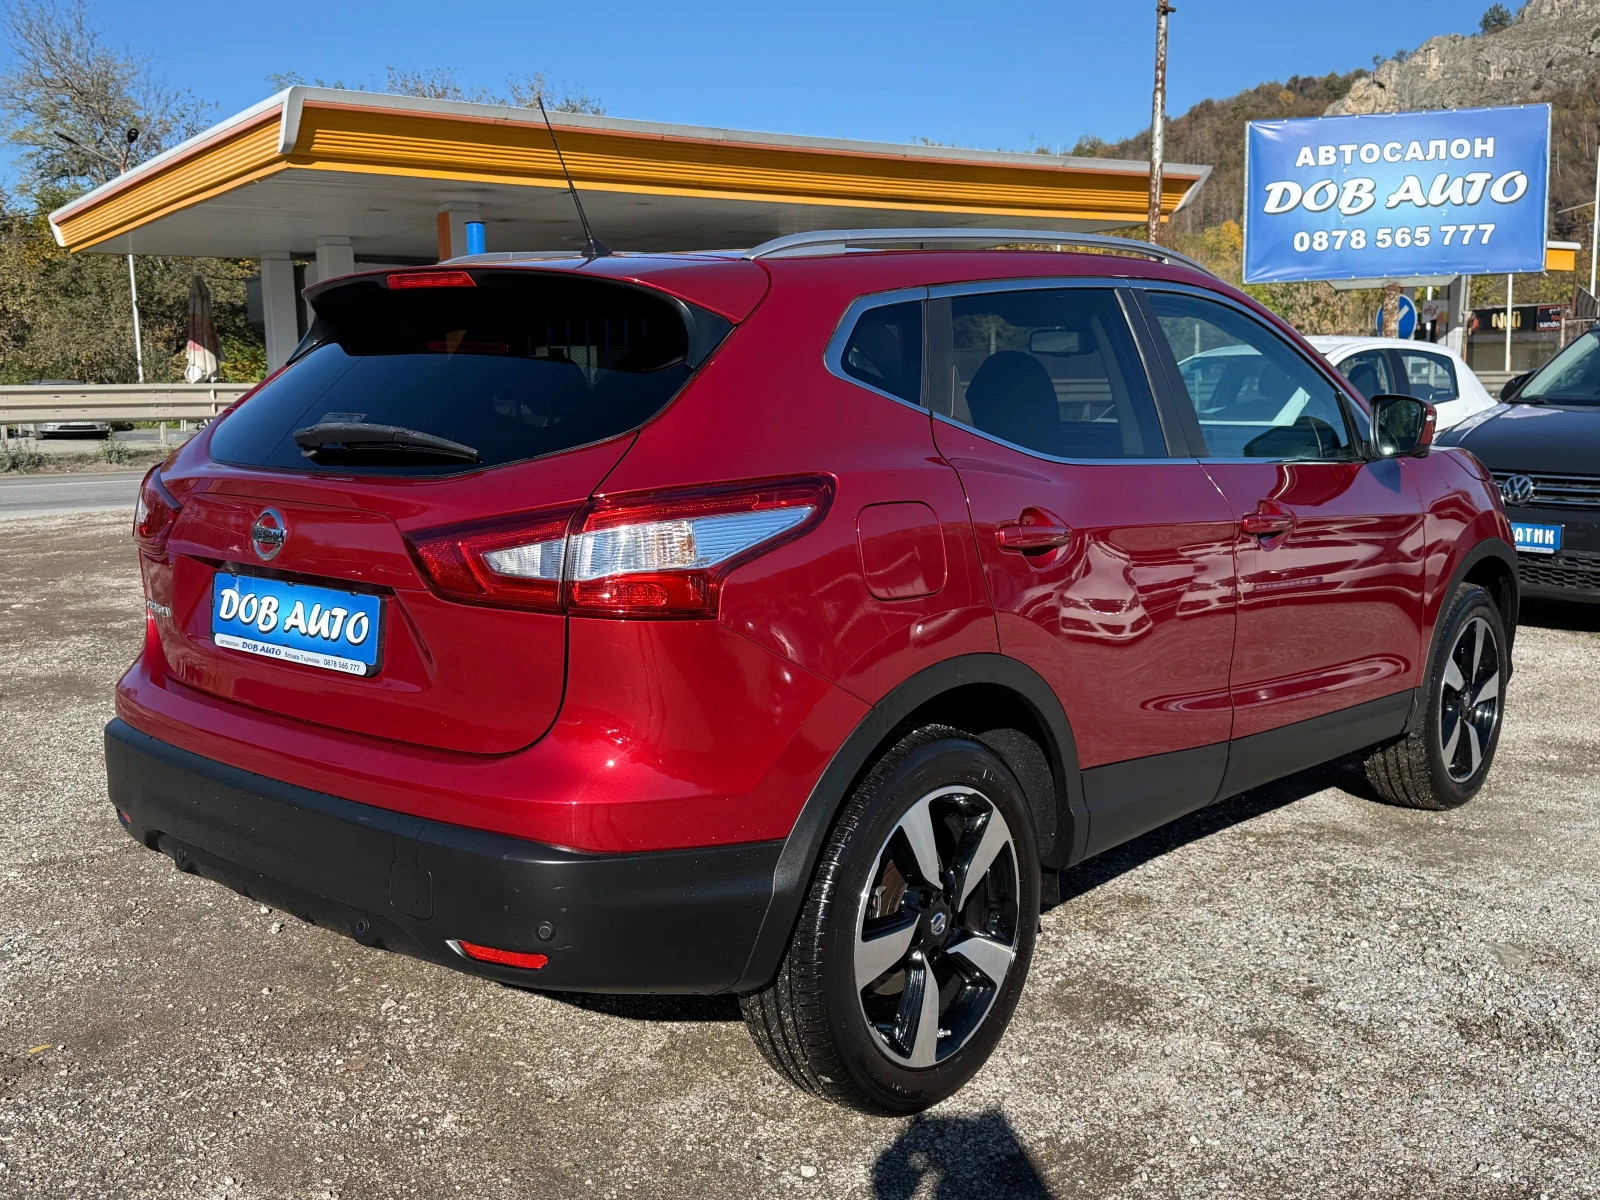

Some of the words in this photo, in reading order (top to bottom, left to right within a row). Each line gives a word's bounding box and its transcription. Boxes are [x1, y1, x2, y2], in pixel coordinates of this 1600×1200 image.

[1295, 136, 1496, 168] АВТОСАЛОН
[1263, 177, 1376, 216] DOB
[1385, 170, 1529, 208] AUTO
[1293, 229, 1367, 252] 0878
[1375, 226, 1431, 248] 565
[1440, 223, 1496, 246] 777
[1512, 527, 1555, 545] АТИК
[219, 588, 279, 633] DOB
[283, 600, 369, 646] AUTO
[241, 641, 259, 652] DOB
[259, 645, 282, 656] AUTO
[323, 658, 337, 667] 0878
[338, 661, 349, 670] 565
[350, 664, 360, 672] 777
